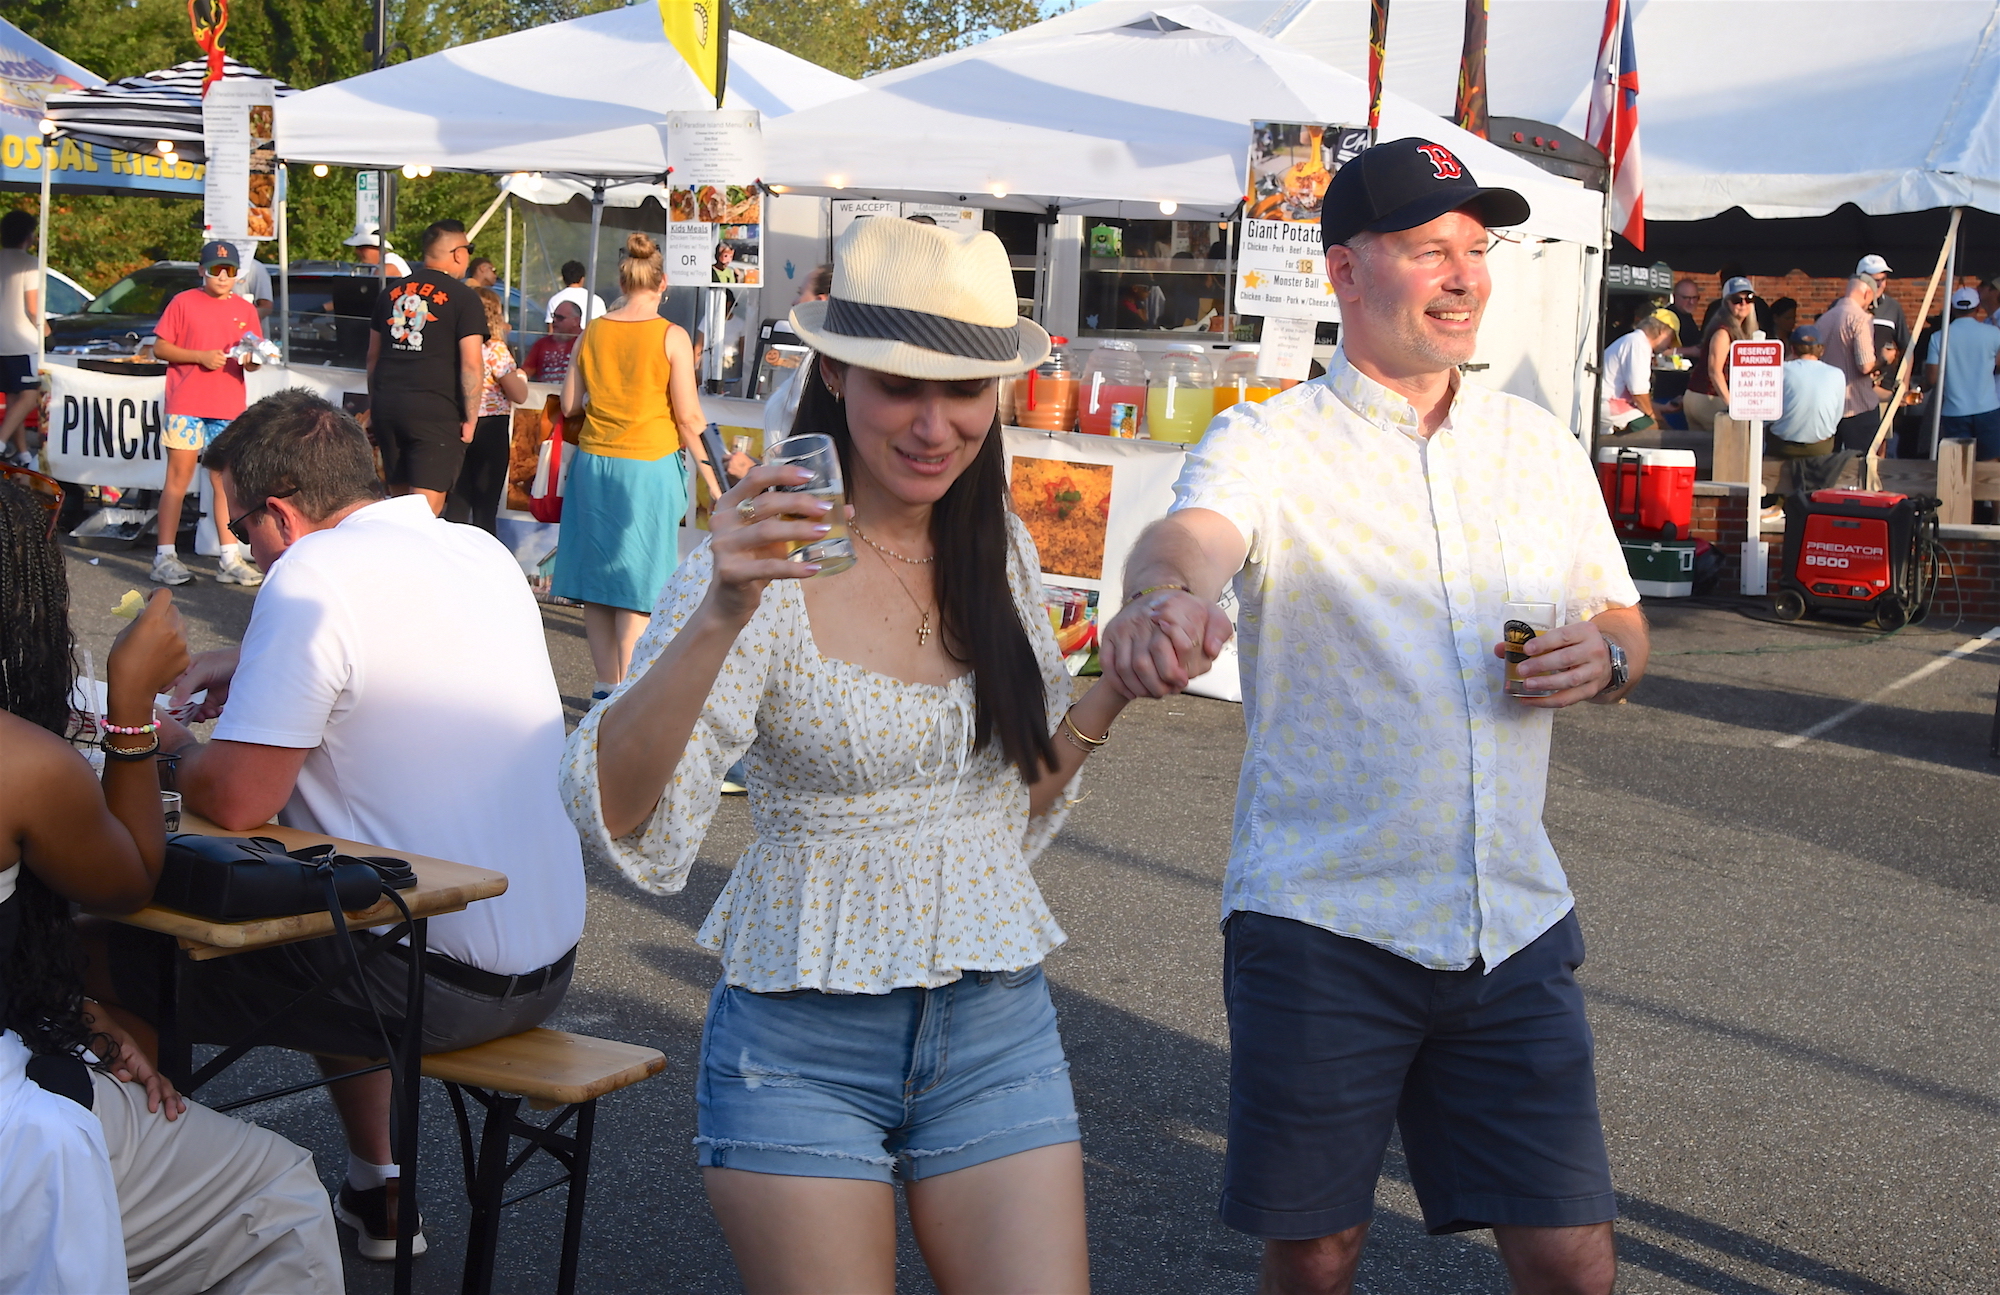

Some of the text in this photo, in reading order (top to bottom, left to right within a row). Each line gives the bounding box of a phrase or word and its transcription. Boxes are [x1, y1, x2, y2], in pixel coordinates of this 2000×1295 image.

[1415, 144, 1462, 180] B
[360, 176, 366, 188] 3
[840, 204, 893, 212] WE ACCEPT:
[670, 224, 708, 233] Kids Meals
[1248, 220, 1322, 243] Giant Potato
[216, 244, 228, 257] LA
[1248, 242, 1268, 252] Chicken
[1272, 244, 1284, 253] Pork
[1290, 246, 1302, 254] Beef
[1307, 247, 1323, 256] Bacon
[681, 255, 697, 266] OR
[1274, 275, 1319, 288] Monster Ball
[1240, 292, 1261, 300] Chicken
[1266, 294, 1282, 303] Bacon
[1287, 296, 1298, 304] Pork
[1737, 347, 1776, 356] RESERVED
[1740, 356, 1773, 364] PARKING
[62, 394, 162, 460] PINCH
[1806, 541, 1883, 556] PREDATOR
[1805, 555, 1850, 568] 9500
